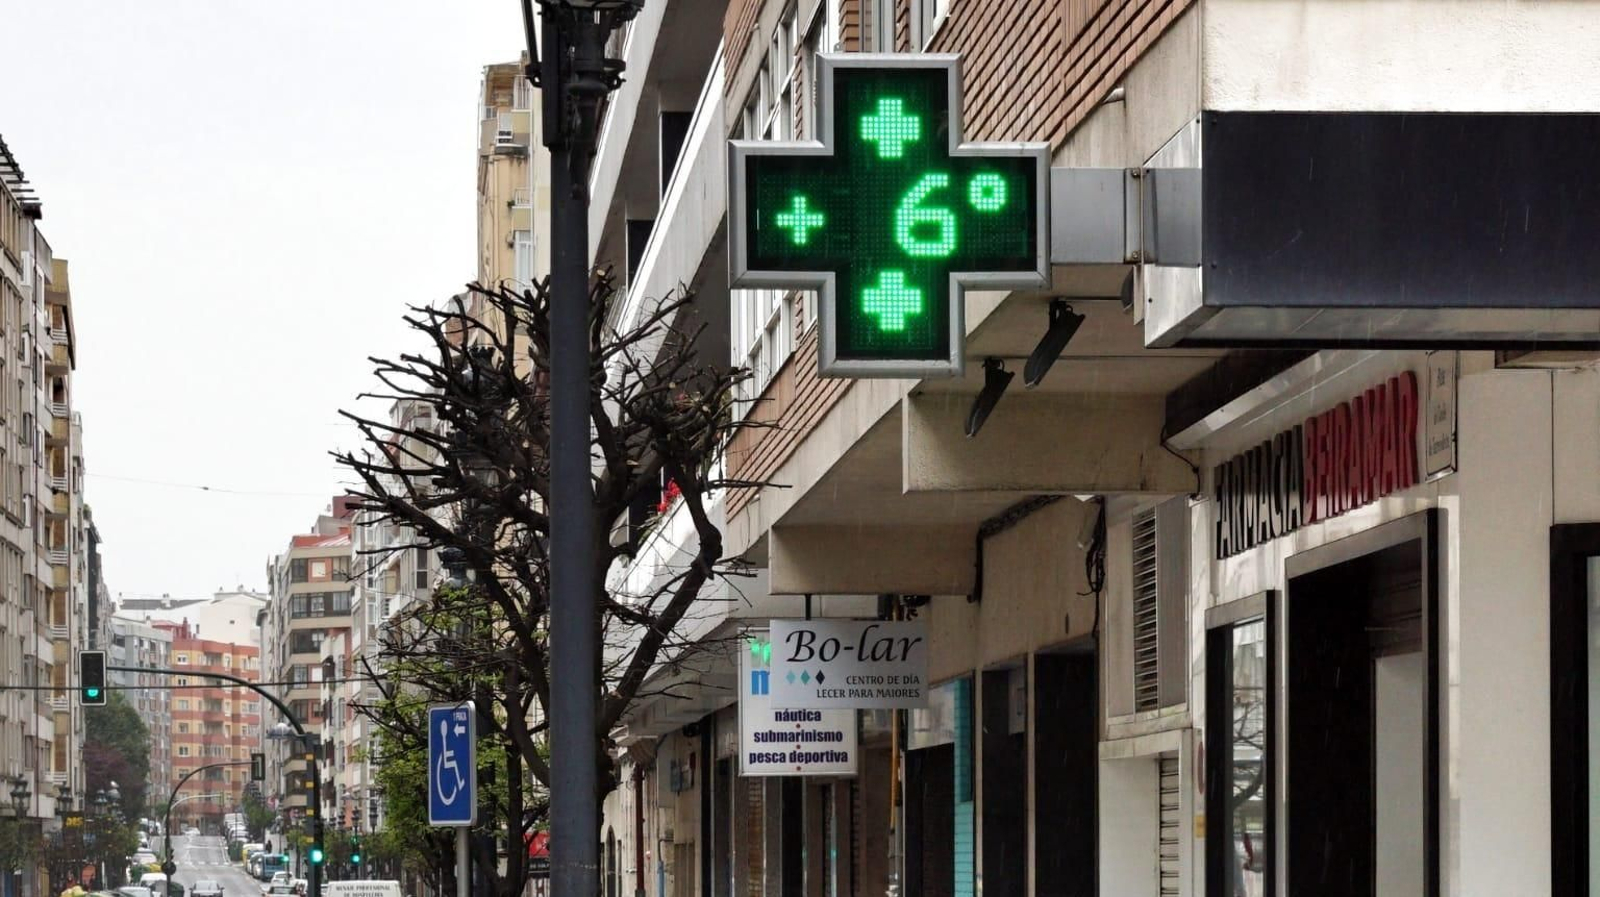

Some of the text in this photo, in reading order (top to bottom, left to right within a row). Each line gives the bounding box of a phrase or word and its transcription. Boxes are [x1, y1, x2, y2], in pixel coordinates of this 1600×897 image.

[1303, 370, 1419, 526] BEIRAMAR
[785, 624, 923, 663] Bo-lar
[846, 672, 920, 685] CENTRO DE DÍA
[816, 688, 920, 699] LECER PARA MAIORES
[774, 708, 822, 722] náutica
[753, 729, 843, 743] submarinismo
[749, 750, 848, 765] pesca deportiva
